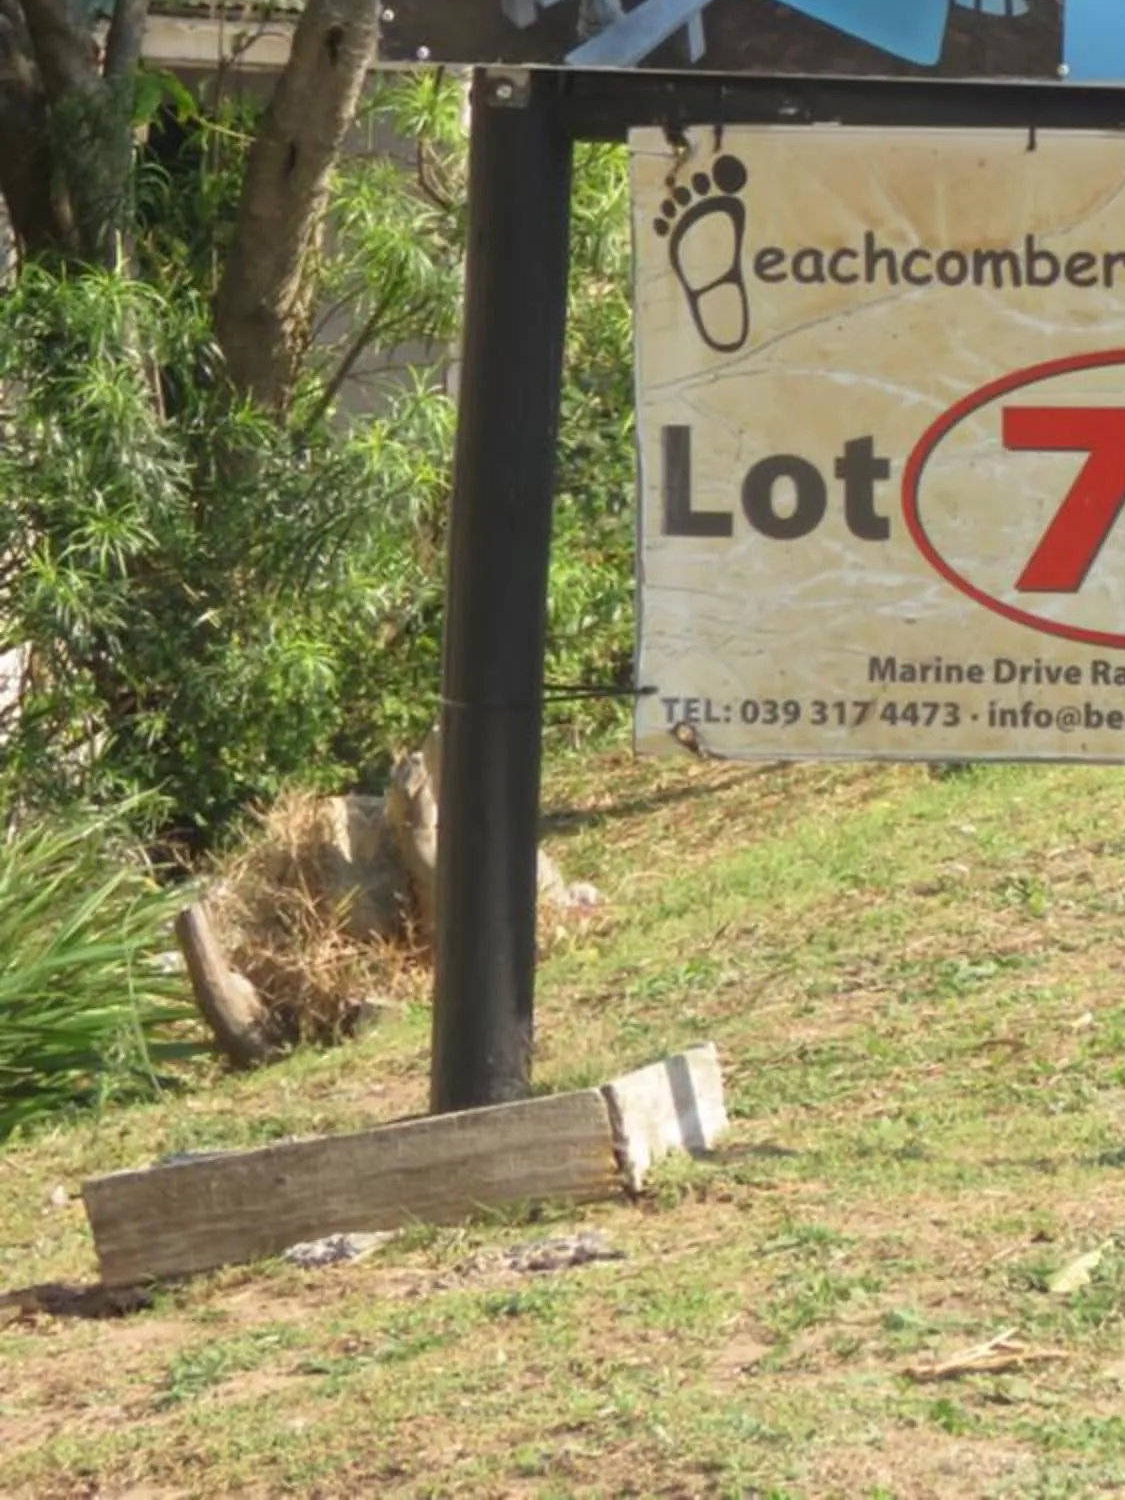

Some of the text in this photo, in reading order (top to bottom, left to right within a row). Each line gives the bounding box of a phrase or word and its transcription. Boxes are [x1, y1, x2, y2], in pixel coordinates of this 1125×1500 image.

[660, 423, 891, 541] Lot
[867, 656, 985, 684] Marine
[993, 657, 1082, 685] Drive
[660, 697, 732, 725] TEL:
[739, 700, 801, 726] 039
[809, 700, 871, 726] 317
[878, 701, 961, 728] 4473
